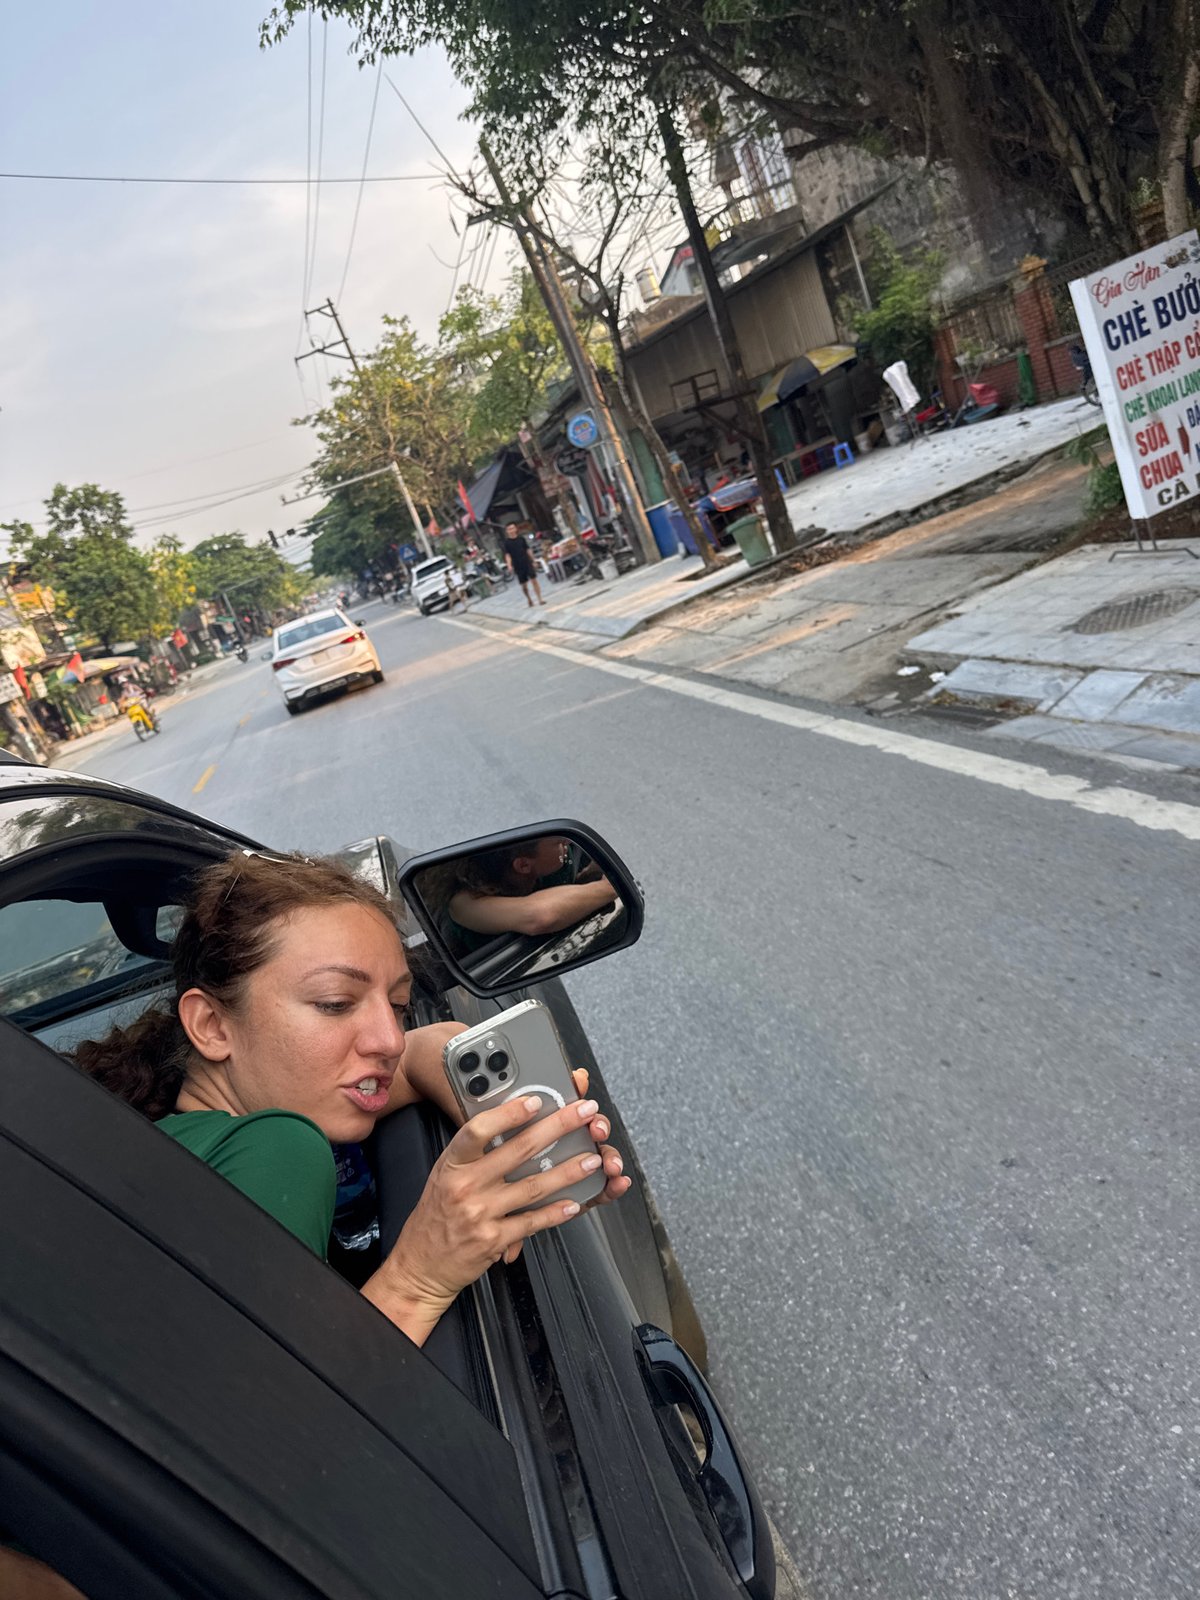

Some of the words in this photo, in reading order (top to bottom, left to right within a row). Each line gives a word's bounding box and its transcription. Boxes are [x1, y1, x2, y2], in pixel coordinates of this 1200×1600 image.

[1091, 277, 1122, 308] Gia
[1103, 300, 1151, 351] CHÈ
[1152, 272, 1200, 330] BƯỞ
[1116, 353, 1147, 391] CHÈ
[1145, 340, 1182, 376] THẬP
[1124, 392, 1147, 423] CHÈ
[1145, 381, 1179, 413] KHOAI
[1178, 368, 1200, 398] LAN
[1135, 421, 1170, 457] SỮA
[1139, 451, 1184, 490] CHUA
[1157, 478, 1190, 506] CÀ
